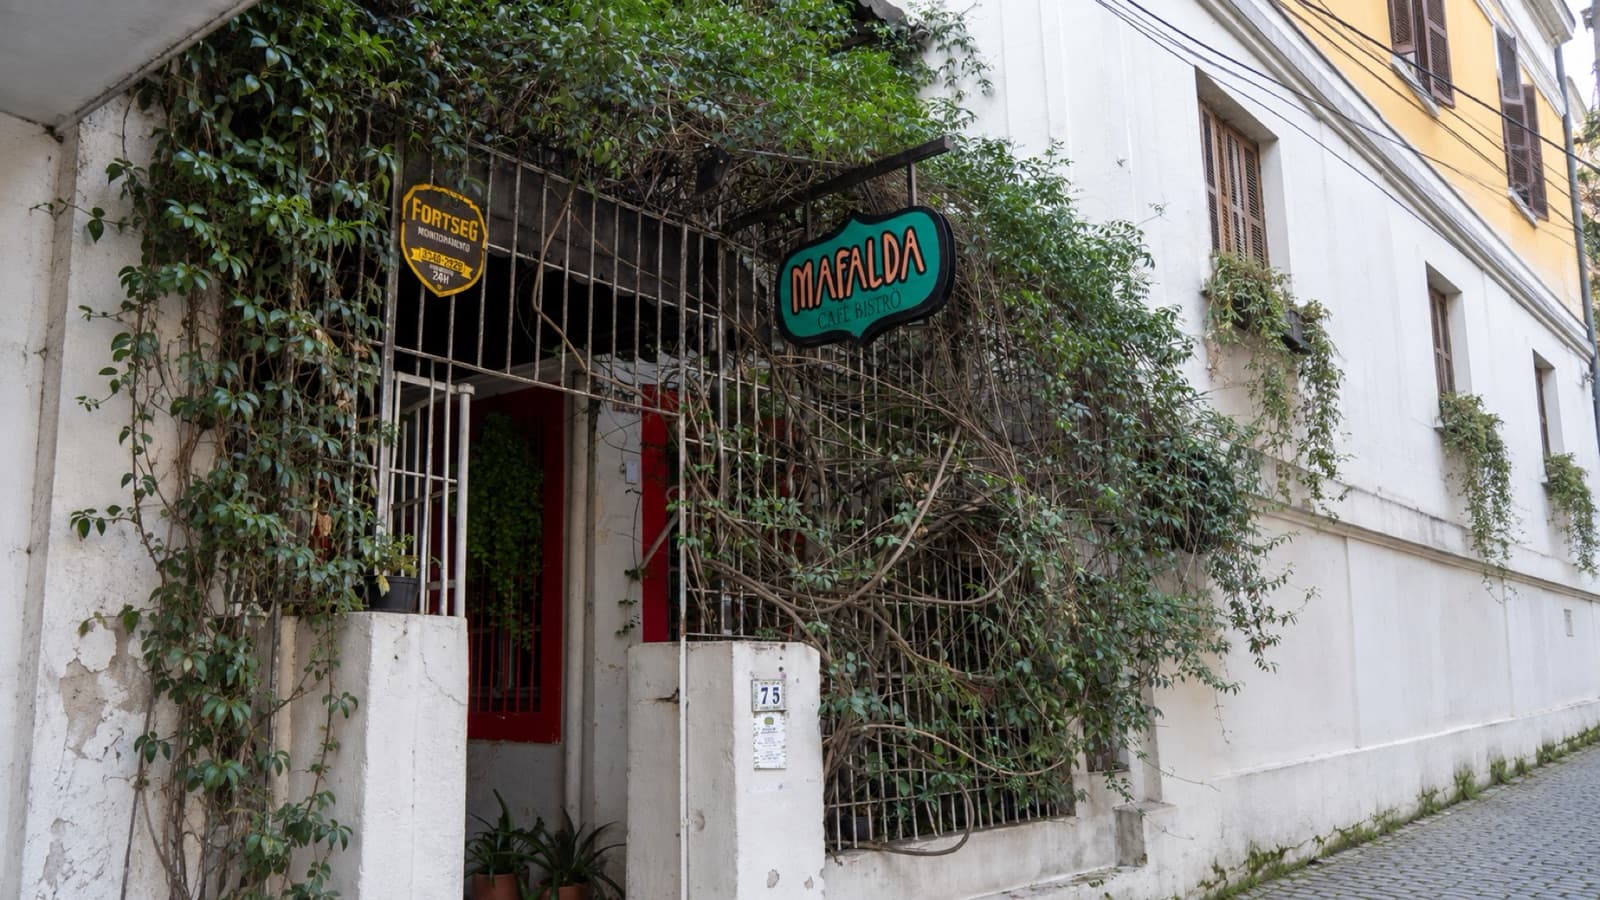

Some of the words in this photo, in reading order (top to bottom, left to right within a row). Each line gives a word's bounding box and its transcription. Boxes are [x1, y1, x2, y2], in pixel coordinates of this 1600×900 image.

[411, 197, 478, 242] FORTSEG
[432, 271, 449, 284] 24H
[791, 228, 926, 314] MAFALDA
[761, 686, 780, 704] 75
